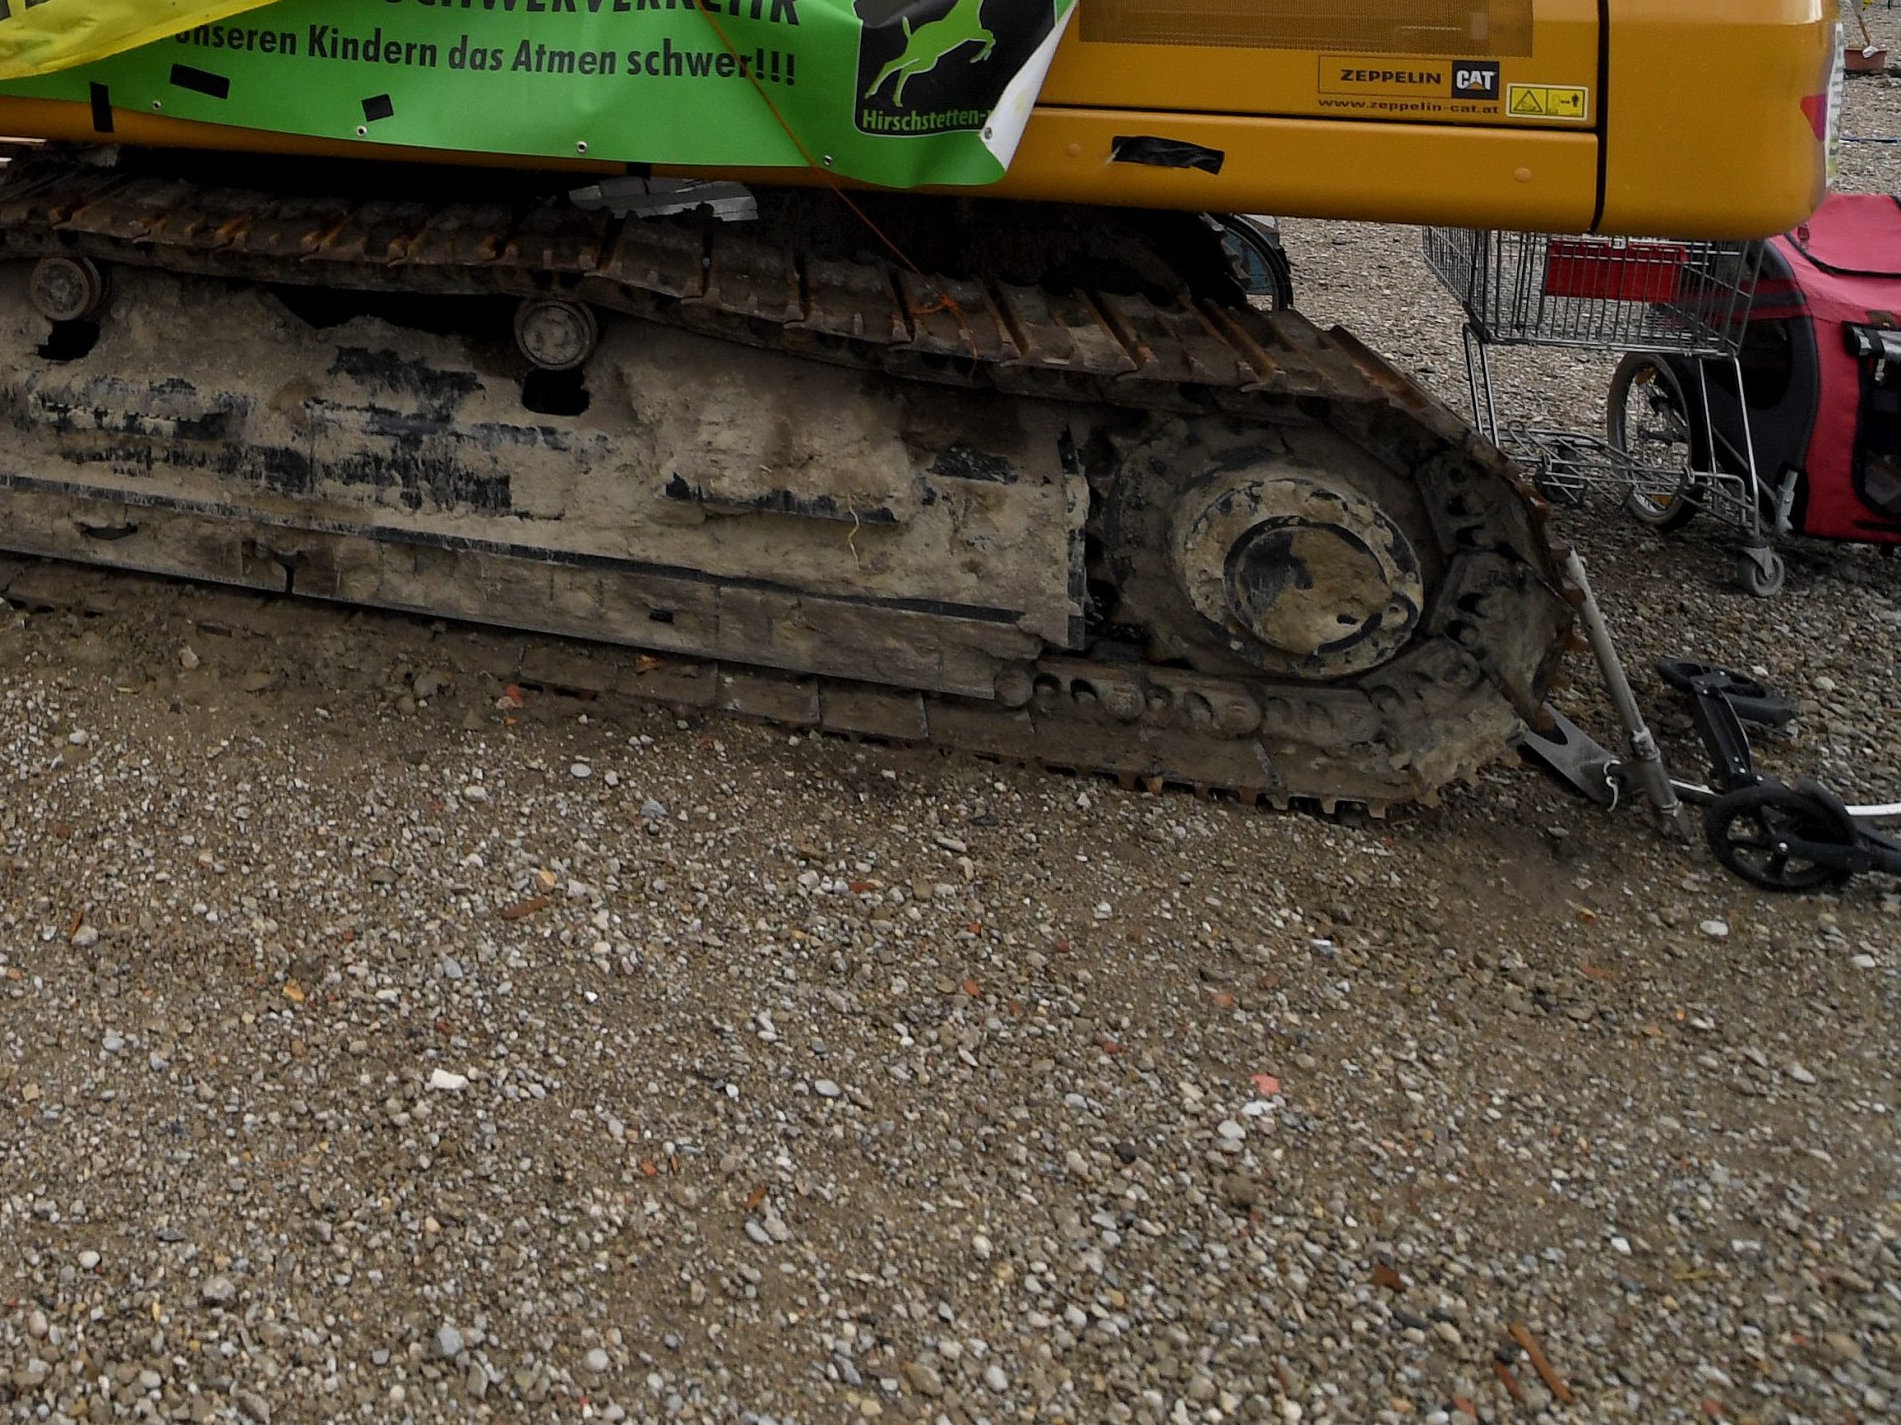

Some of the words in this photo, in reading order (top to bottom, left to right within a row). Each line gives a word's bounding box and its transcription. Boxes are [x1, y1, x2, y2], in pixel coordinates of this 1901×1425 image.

[308, 24, 437, 67] Kindern
[448, 34, 504, 71] das
[511, 39, 617, 75] Atmen
[627, 38, 796, 86] schwer!!!
[1340, 69, 1442, 85] ZEPPELIN
[1456, 70, 1496, 91] CAT
[1318, 99, 1499, 114] www.zeppelin-cat.at
[862, 109, 993, 131] Hirschstetten-
